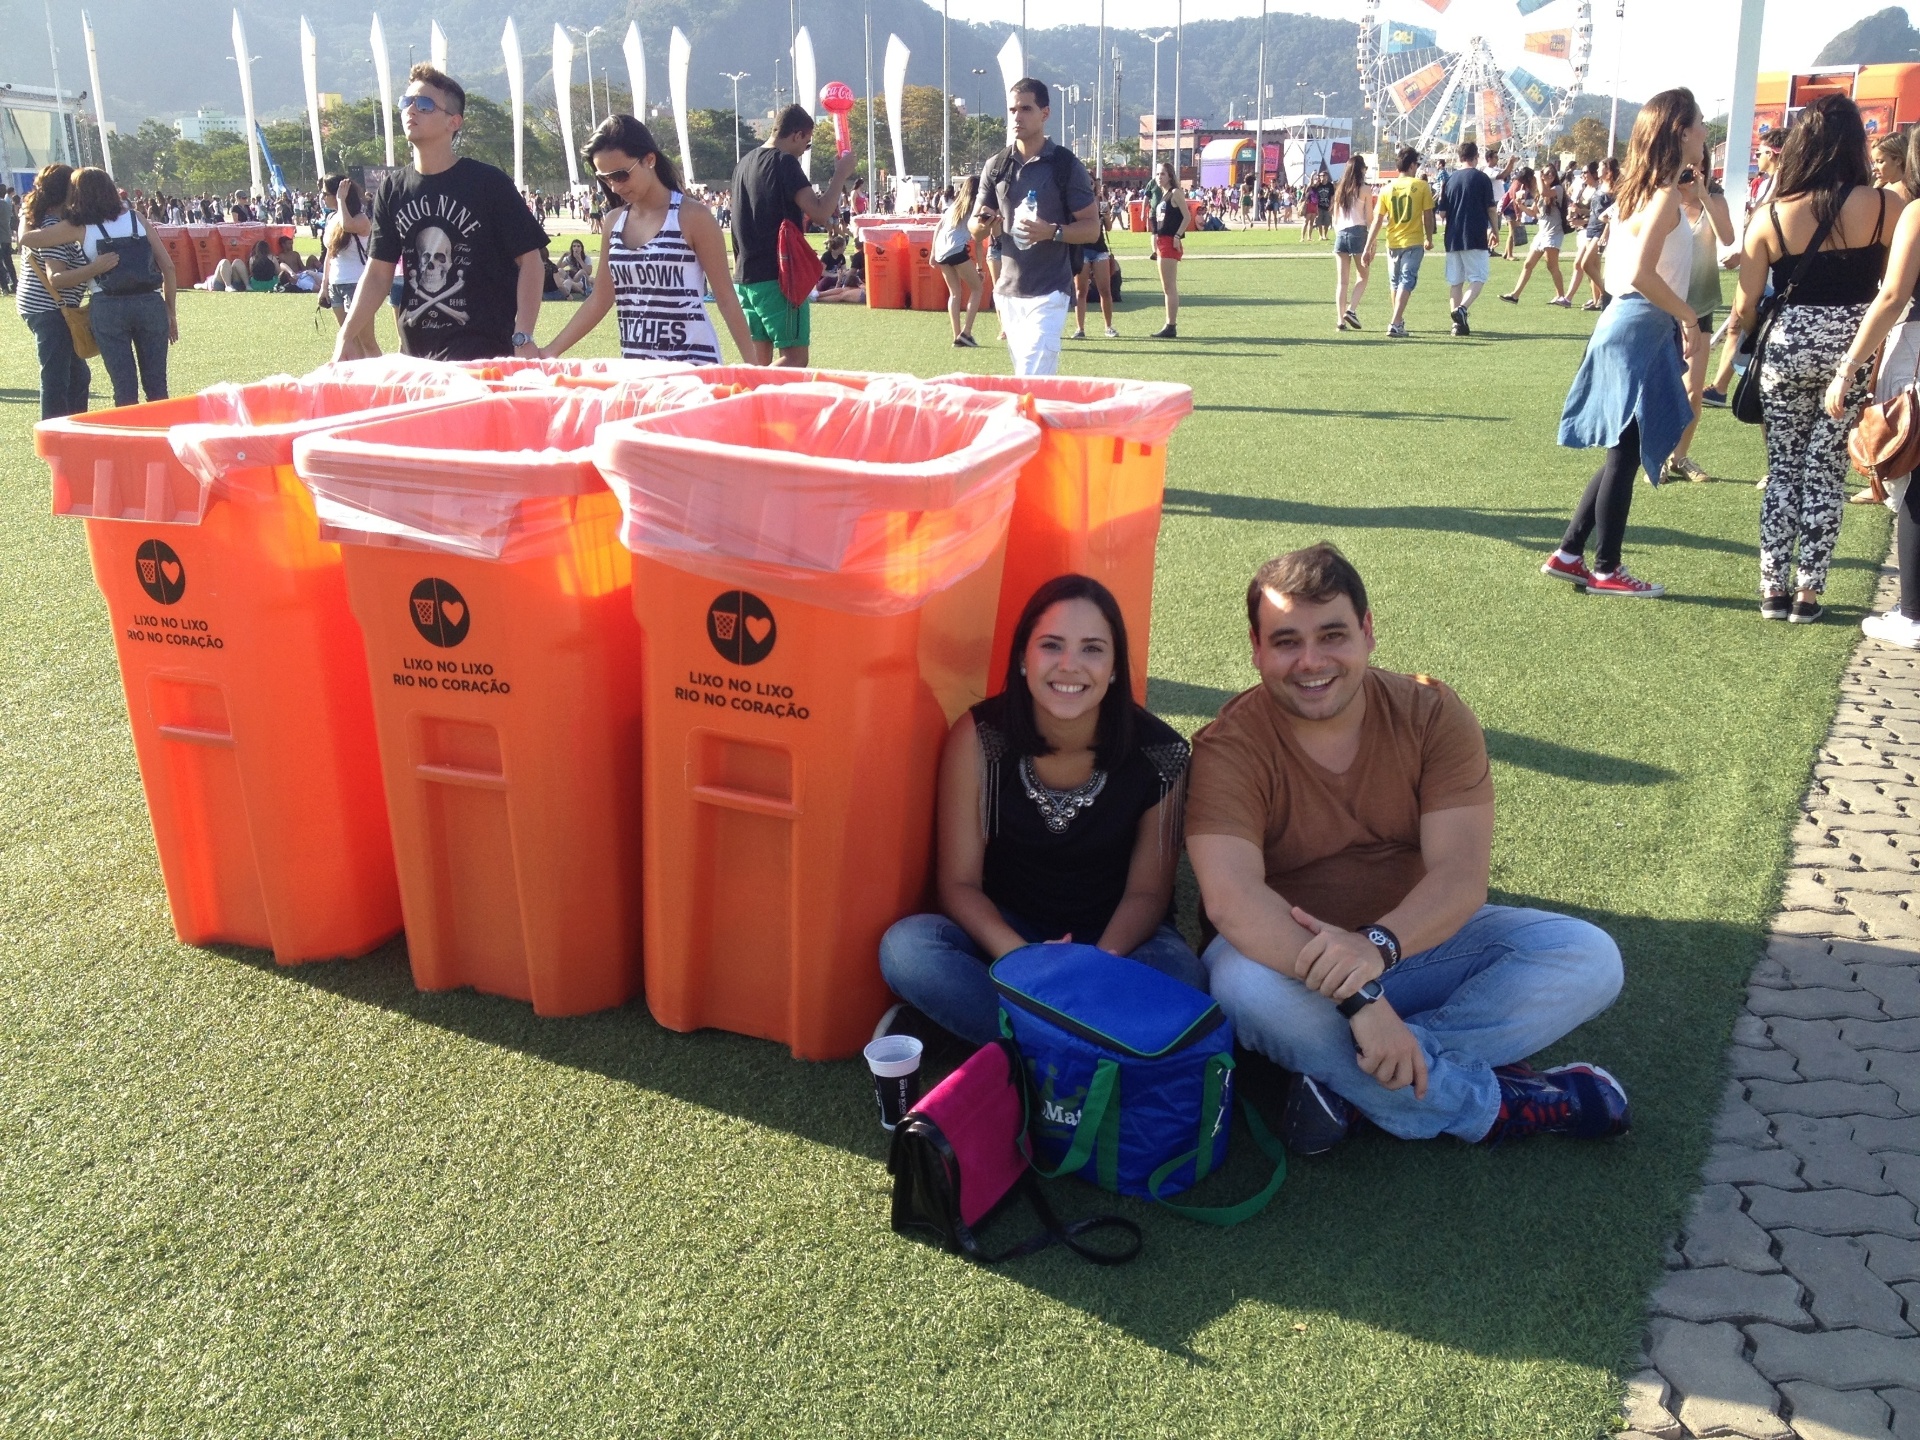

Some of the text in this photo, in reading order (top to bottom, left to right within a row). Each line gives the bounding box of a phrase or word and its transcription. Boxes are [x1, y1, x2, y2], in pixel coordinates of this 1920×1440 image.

[1526, 83, 1545, 105] Rio
[435, 194, 482, 238] NINE
[1391, 193, 1412, 224] 10
[610, 263, 685, 287] OW DOWN
[134, 615, 208, 631] LIXO NO LIXO
[127, 629, 224, 649] RIO NO CORAÇÃO
[403, 658, 493, 676] LIXO NO LIXO
[393, 673, 511, 695] RIO NO CORAÇÃO
[689, 671, 793, 699] LIXO NO LIXO
[675, 686, 810, 719] RIO NO CORAÇÃO
[1044, 1099, 1082, 1126] Mat
